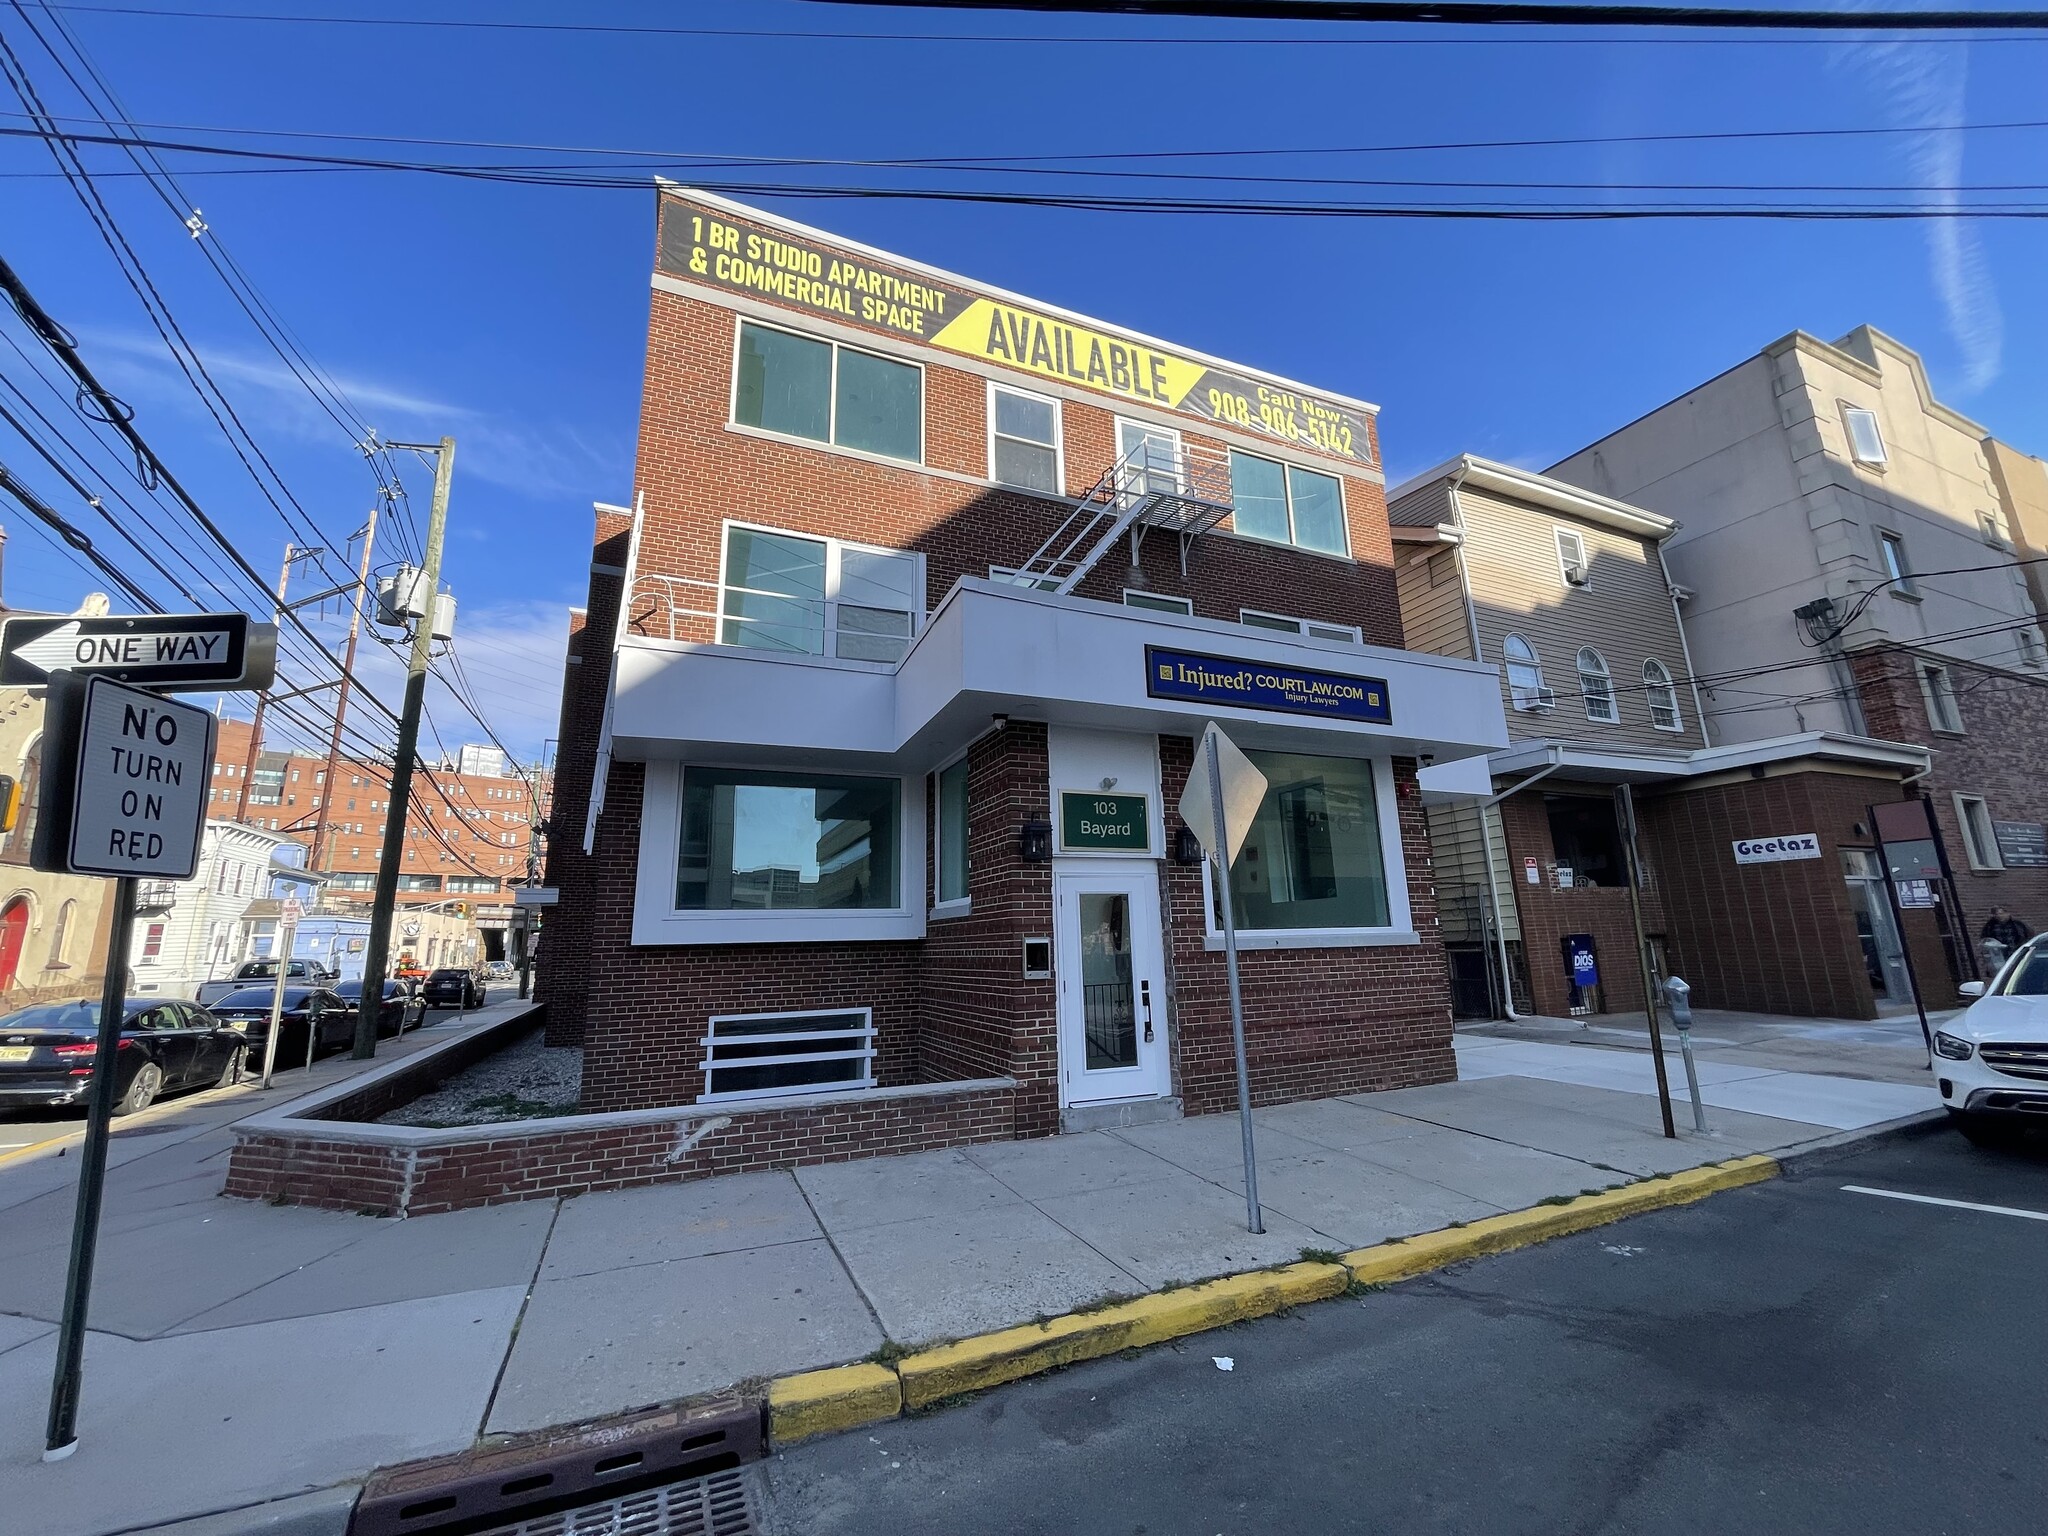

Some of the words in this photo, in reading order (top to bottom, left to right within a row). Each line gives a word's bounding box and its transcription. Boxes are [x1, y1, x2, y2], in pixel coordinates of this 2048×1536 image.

[691, 216, 703, 243] 1
[708, 221, 740, 254] BR
[746, 233, 822, 278] STUDIO
[827, 260, 946, 315] APARTMENT
[688, 246, 708, 275] &
[715, 253, 856, 317] COMMERCIAL
[861, 299, 945, 336] SPACE
[986, 307, 1170, 404] AVAILABLE
[1208, 388, 1355, 457] 908-906-5142
[1257, 386, 1298, 411] Call
[1301, 399, 1349, 426] Now:
[75, 637, 143, 664] ONE
[155, 634, 222, 662] WAY
[1177, 663, 1253, 691] Injured?
[1255, 674, 1364, 701] COURTLAW.COM
[1284, 691, 1308, 705] Injury
[1309, 694, 1340, 707] Lawyers
[122, 703, 178, 746] NO
[110, 746, 183, 787] TURN
[120, 789, 164, 821] ON
[1092, 801, 1118, 816] 103
[108, 828, 164, 860] RED
[1080, 820, 1131, 838] Bayard
[1737, 838, 1815, 856] Geetaz
[1574, 954, 1594, 967] DIOS
